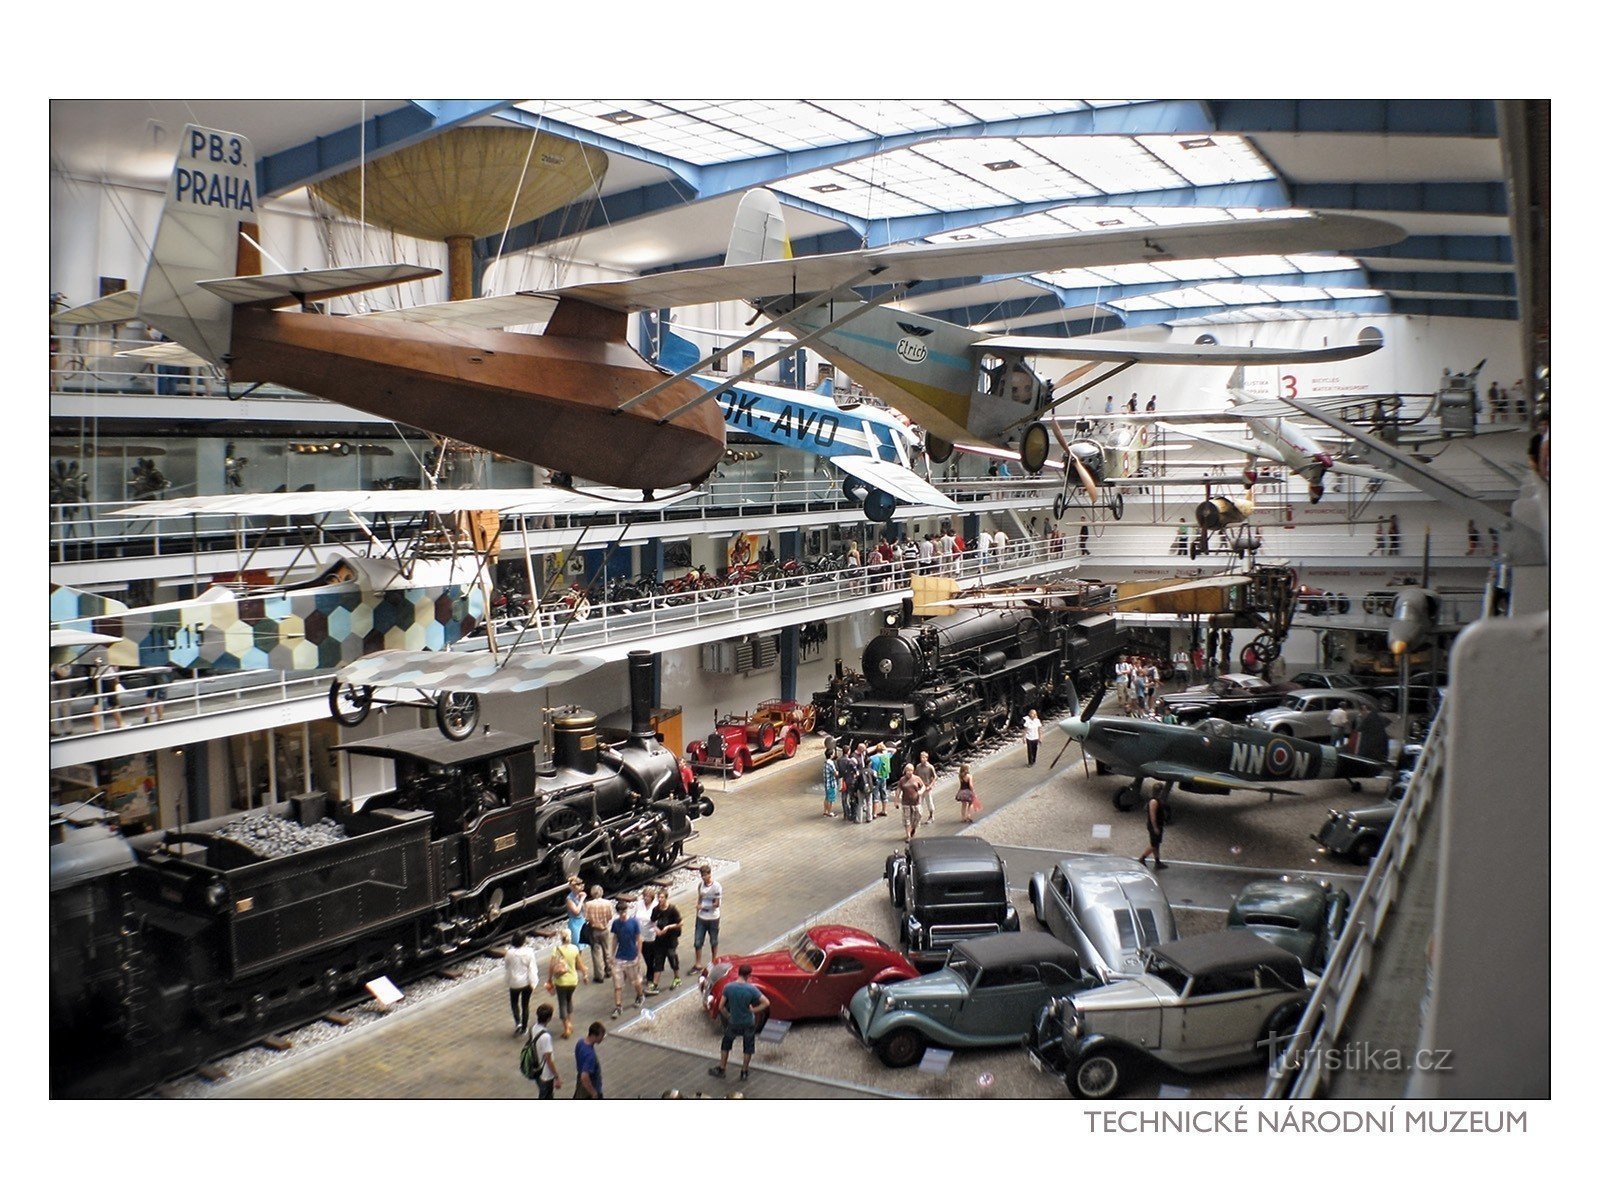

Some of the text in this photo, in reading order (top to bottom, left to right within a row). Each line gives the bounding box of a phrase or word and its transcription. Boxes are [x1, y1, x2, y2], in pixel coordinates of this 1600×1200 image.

[191, 130, 247, 167] PB.3.
[176, 168, 254, 213] PRAHA
[898, 340, 927, 359] Elrich
[1282, 375, 1298, 399] 3
[716, 389, 840, 448] OK-AVO
[1229, 741, 1310, 779] NN N
